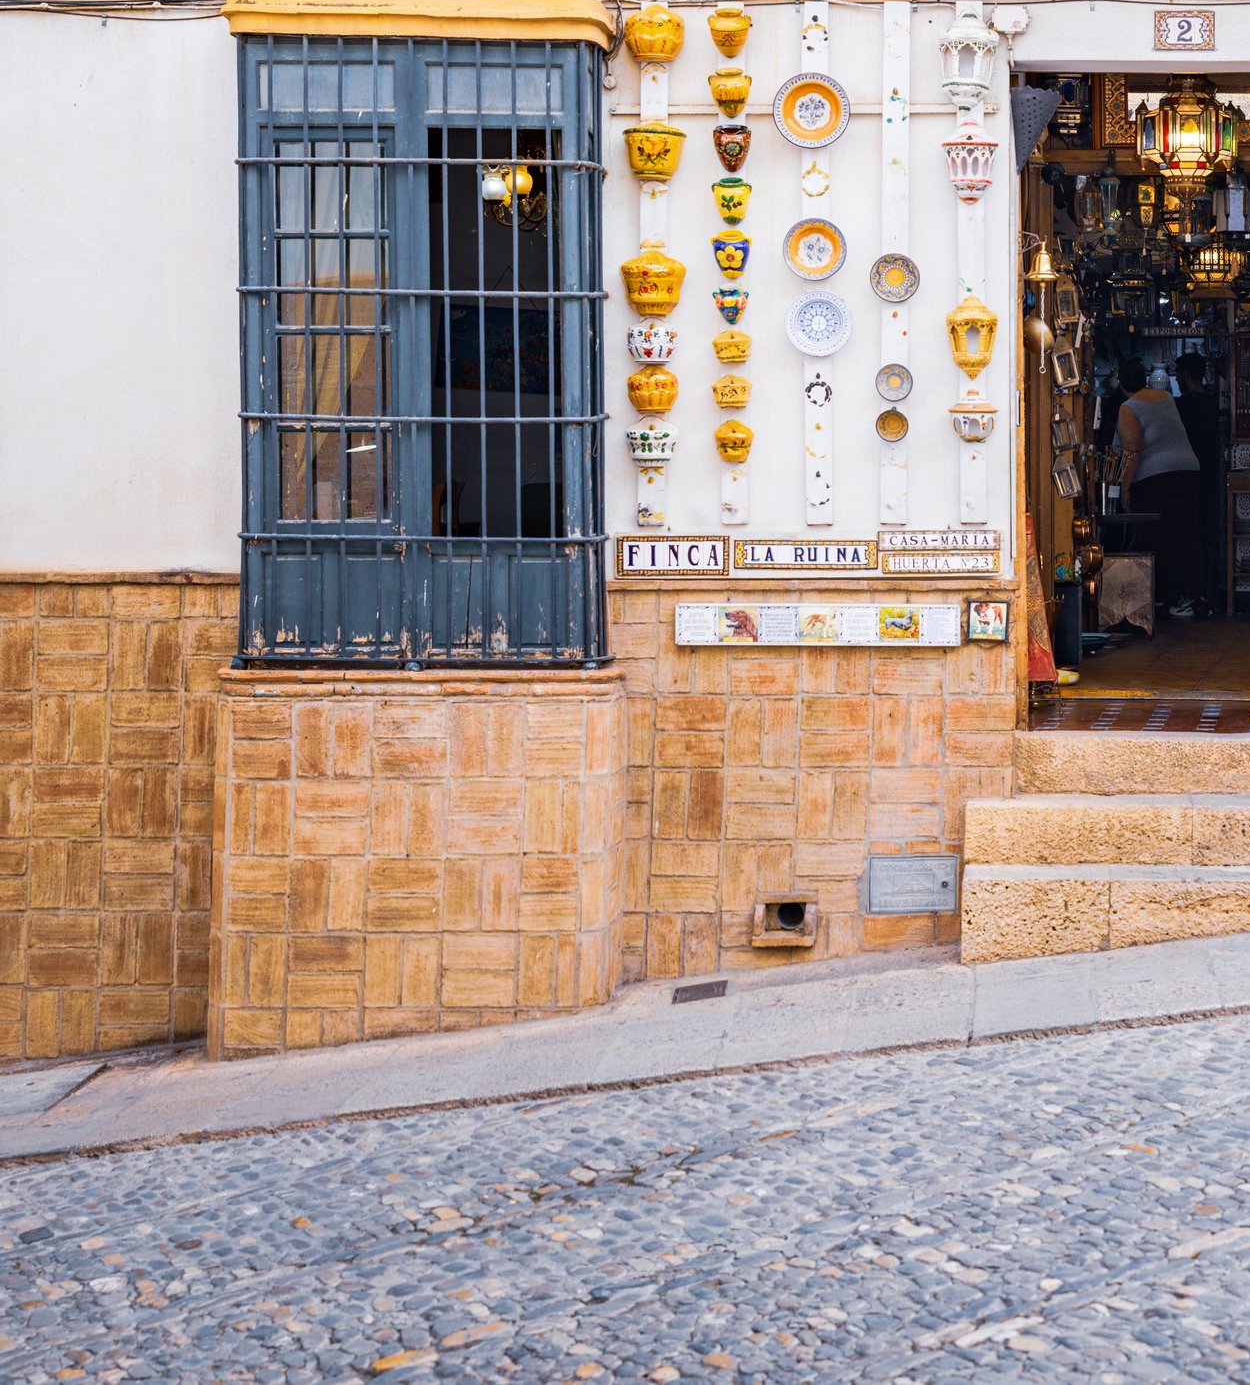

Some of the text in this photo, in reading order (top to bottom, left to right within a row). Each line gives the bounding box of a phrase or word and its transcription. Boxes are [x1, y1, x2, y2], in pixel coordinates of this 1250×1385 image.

[1176, 18, 1193, 43] 2
[889, 534, 990, 546] CASA-MARIA
[627, 543, 719, 567] FINCA
[750, 546, 862, 564] LA RUINA
[893, 557, 951, 569] HUERTA
